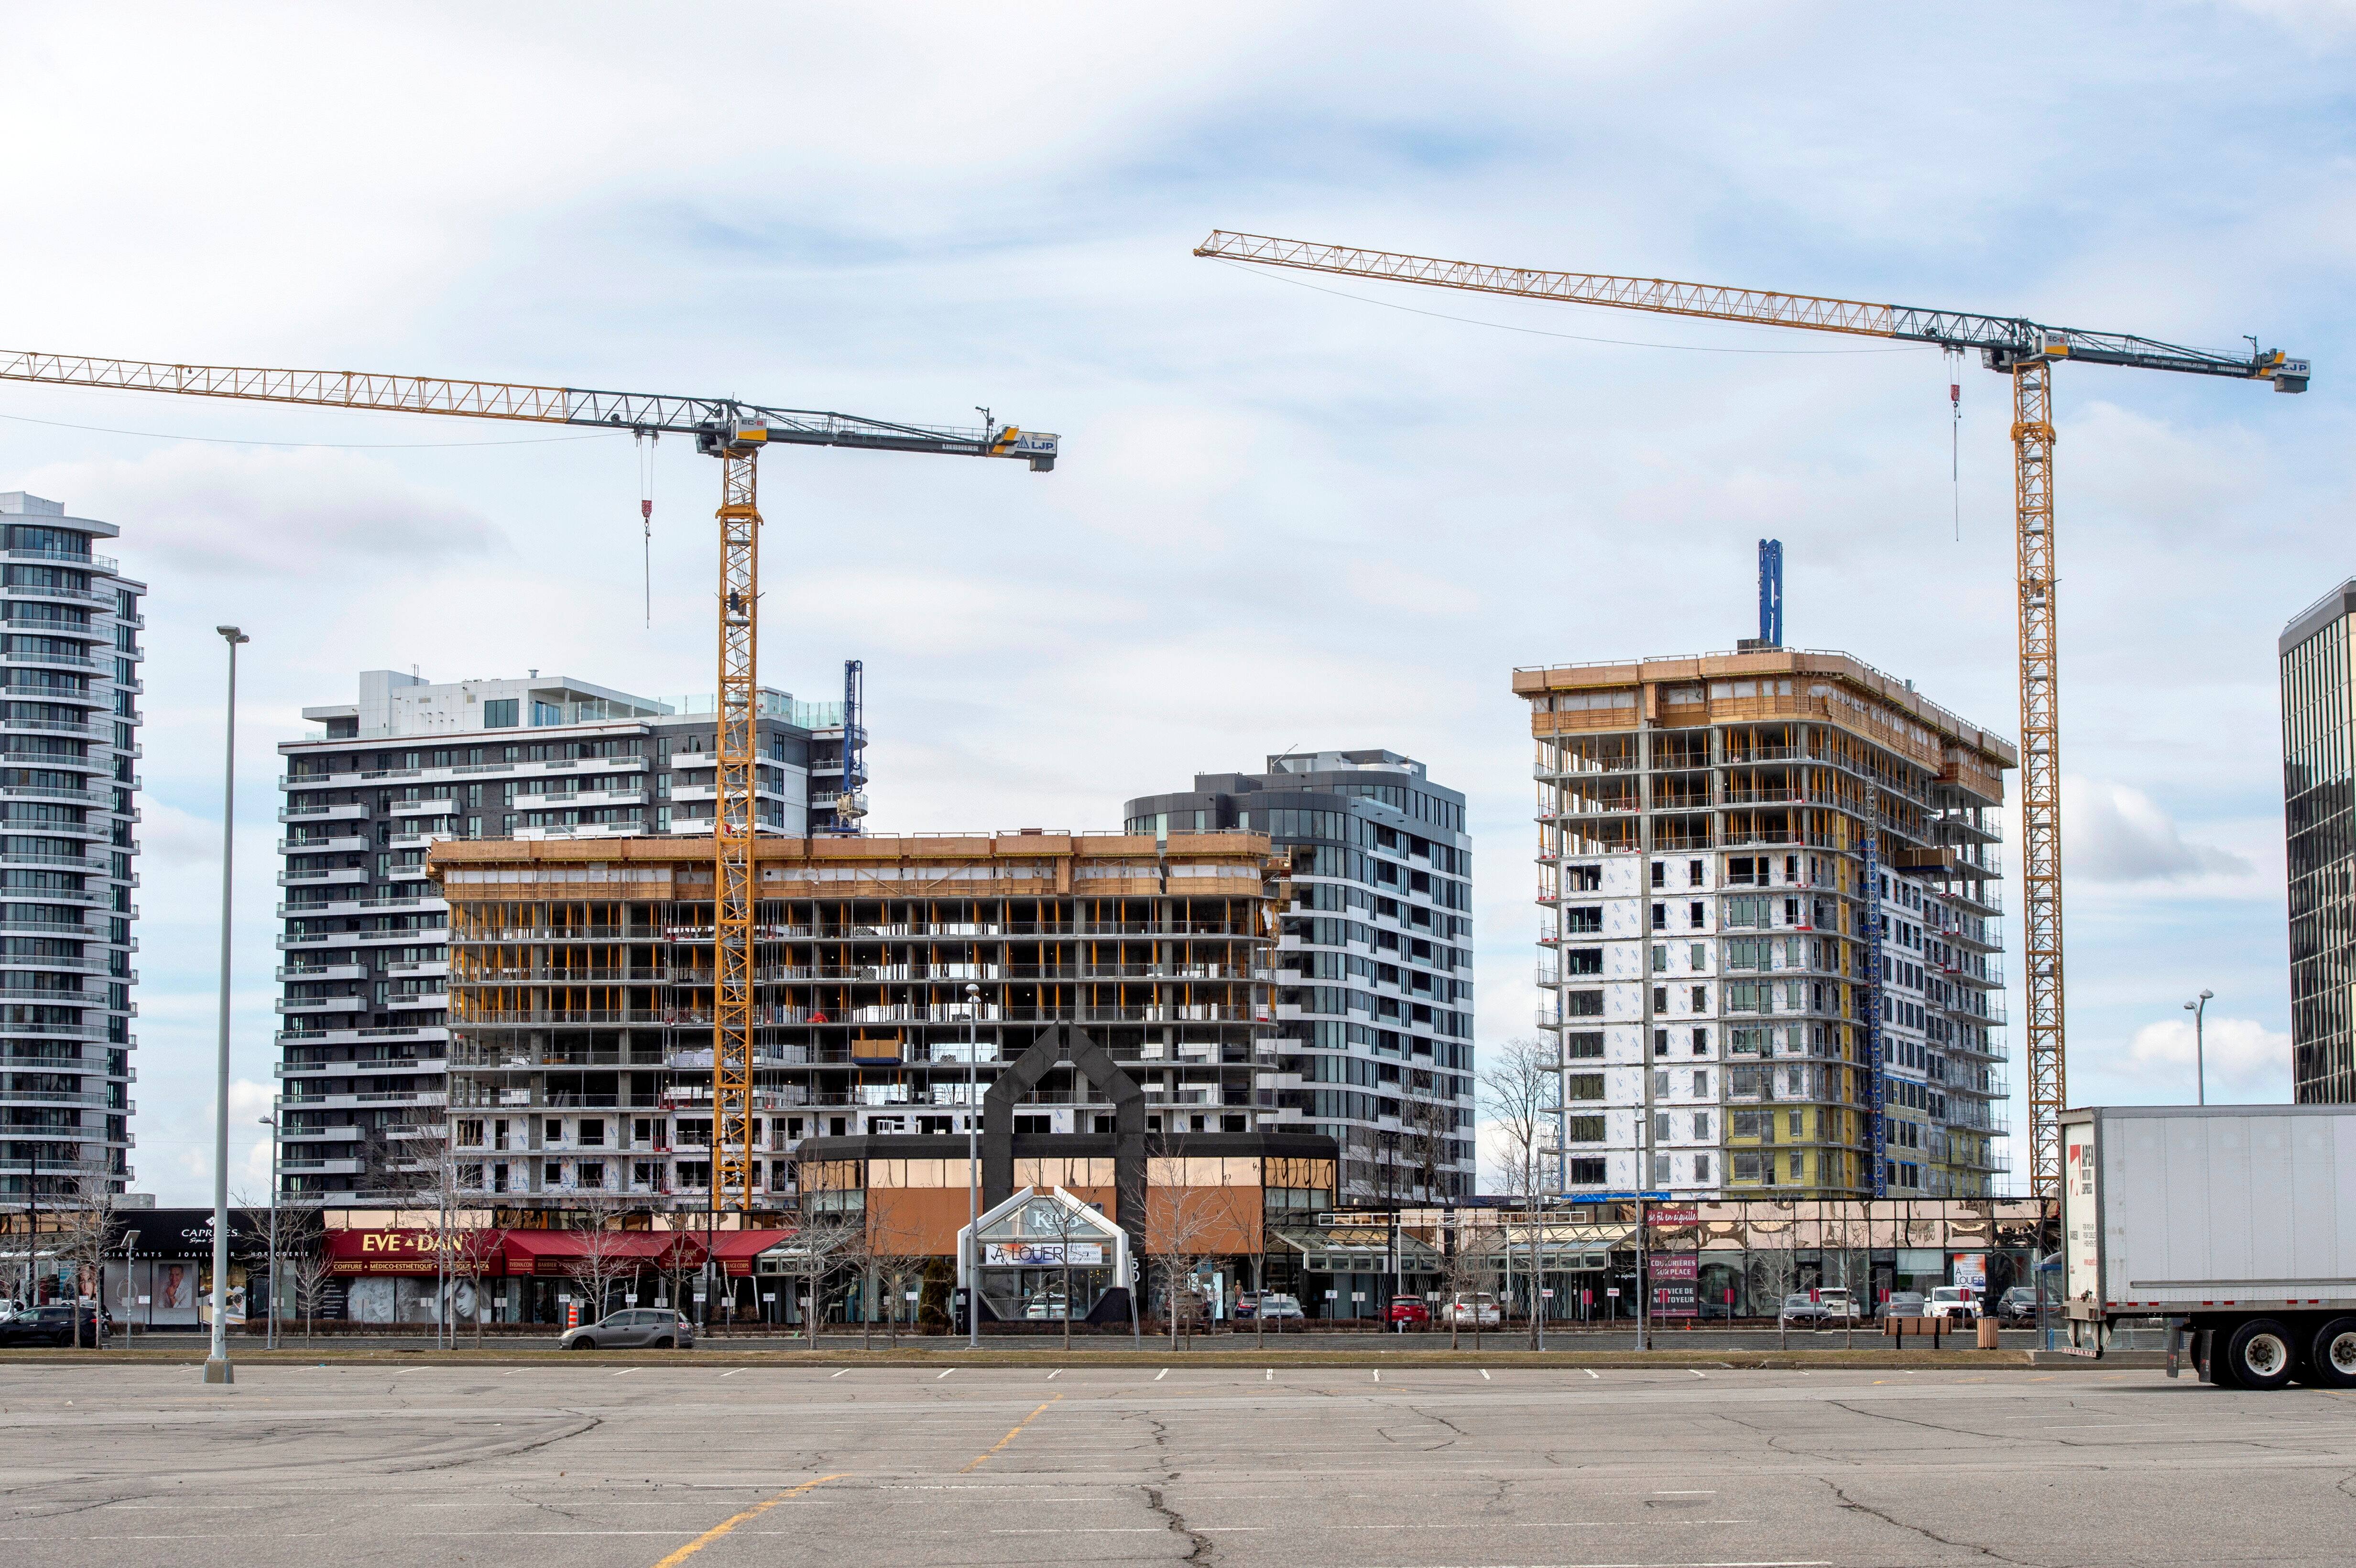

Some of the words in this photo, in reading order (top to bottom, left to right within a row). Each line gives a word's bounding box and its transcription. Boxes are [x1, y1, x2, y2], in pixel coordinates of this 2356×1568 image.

[2217, 365, 2247, 373] LIEBHERR
[942, 443, 979, 452] LIEBHERR
[1032, 441, 1054, 450] LJP
[2082, 1144, 2094, 1167] APEX
[1665, 1213, 1673, 1221] en
[1674, 1211, 1697, 1224] aiguille
[362, 1234, 401, 1251] EVE
[417, 1234, 463, 1252] DAN
[1012, 1246, 1064, 1261] LOUER
[1955, 1276, 1985, 1285] LOUER
